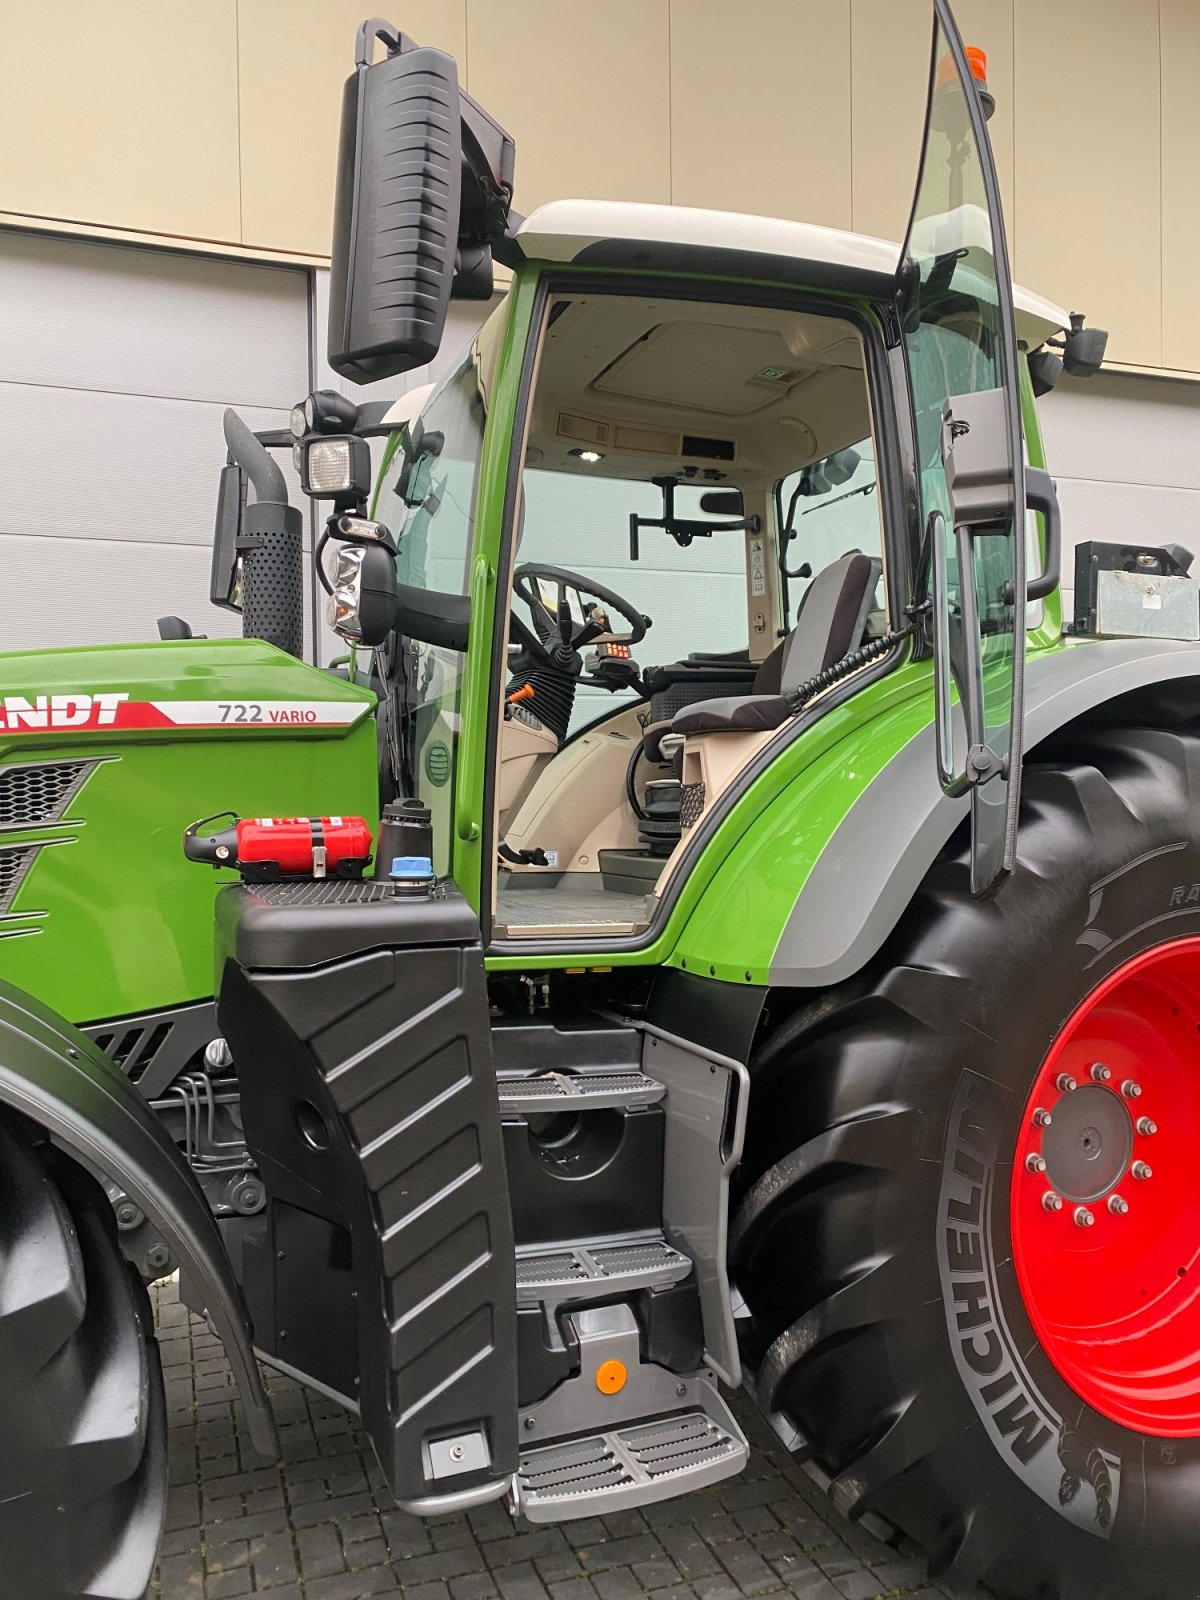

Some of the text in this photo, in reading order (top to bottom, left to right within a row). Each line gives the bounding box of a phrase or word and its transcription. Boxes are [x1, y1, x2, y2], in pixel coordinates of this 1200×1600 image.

[0, 693, 316, 728] NDT 722 VARIO
[946, 1082, 1055, 1467] MICHELIN
